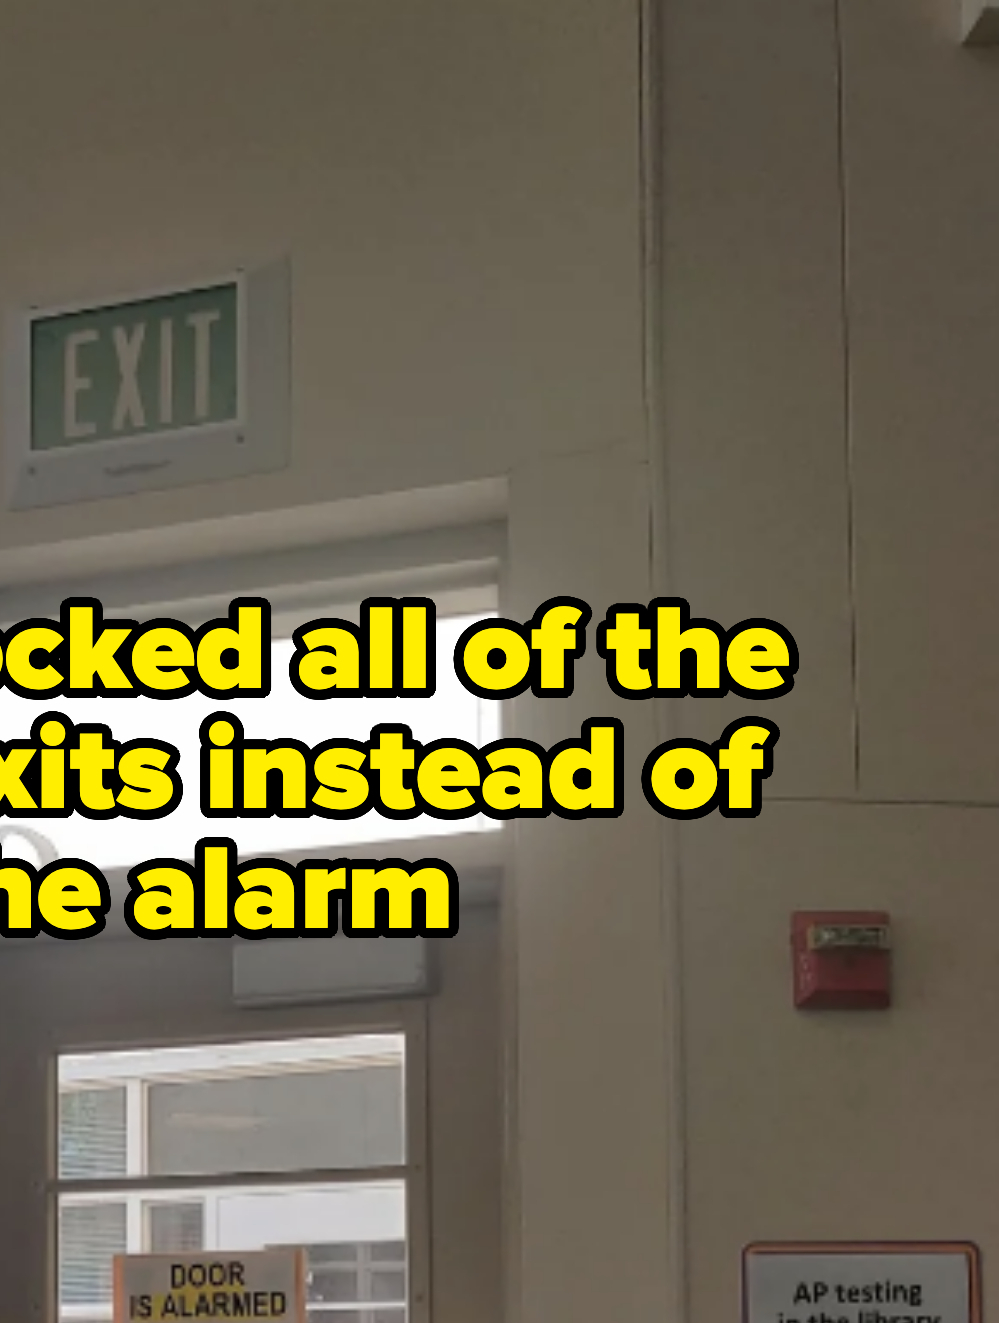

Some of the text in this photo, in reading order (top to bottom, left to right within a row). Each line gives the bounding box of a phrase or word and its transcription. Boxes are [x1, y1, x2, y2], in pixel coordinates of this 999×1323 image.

[63, 309, 221, 438] EXIT
[170, 1261, 246, 1289] DOOR
[129, 1292, 287, 1320] IS ALARMED
[793, 1279, 922, 1307] AP testing
